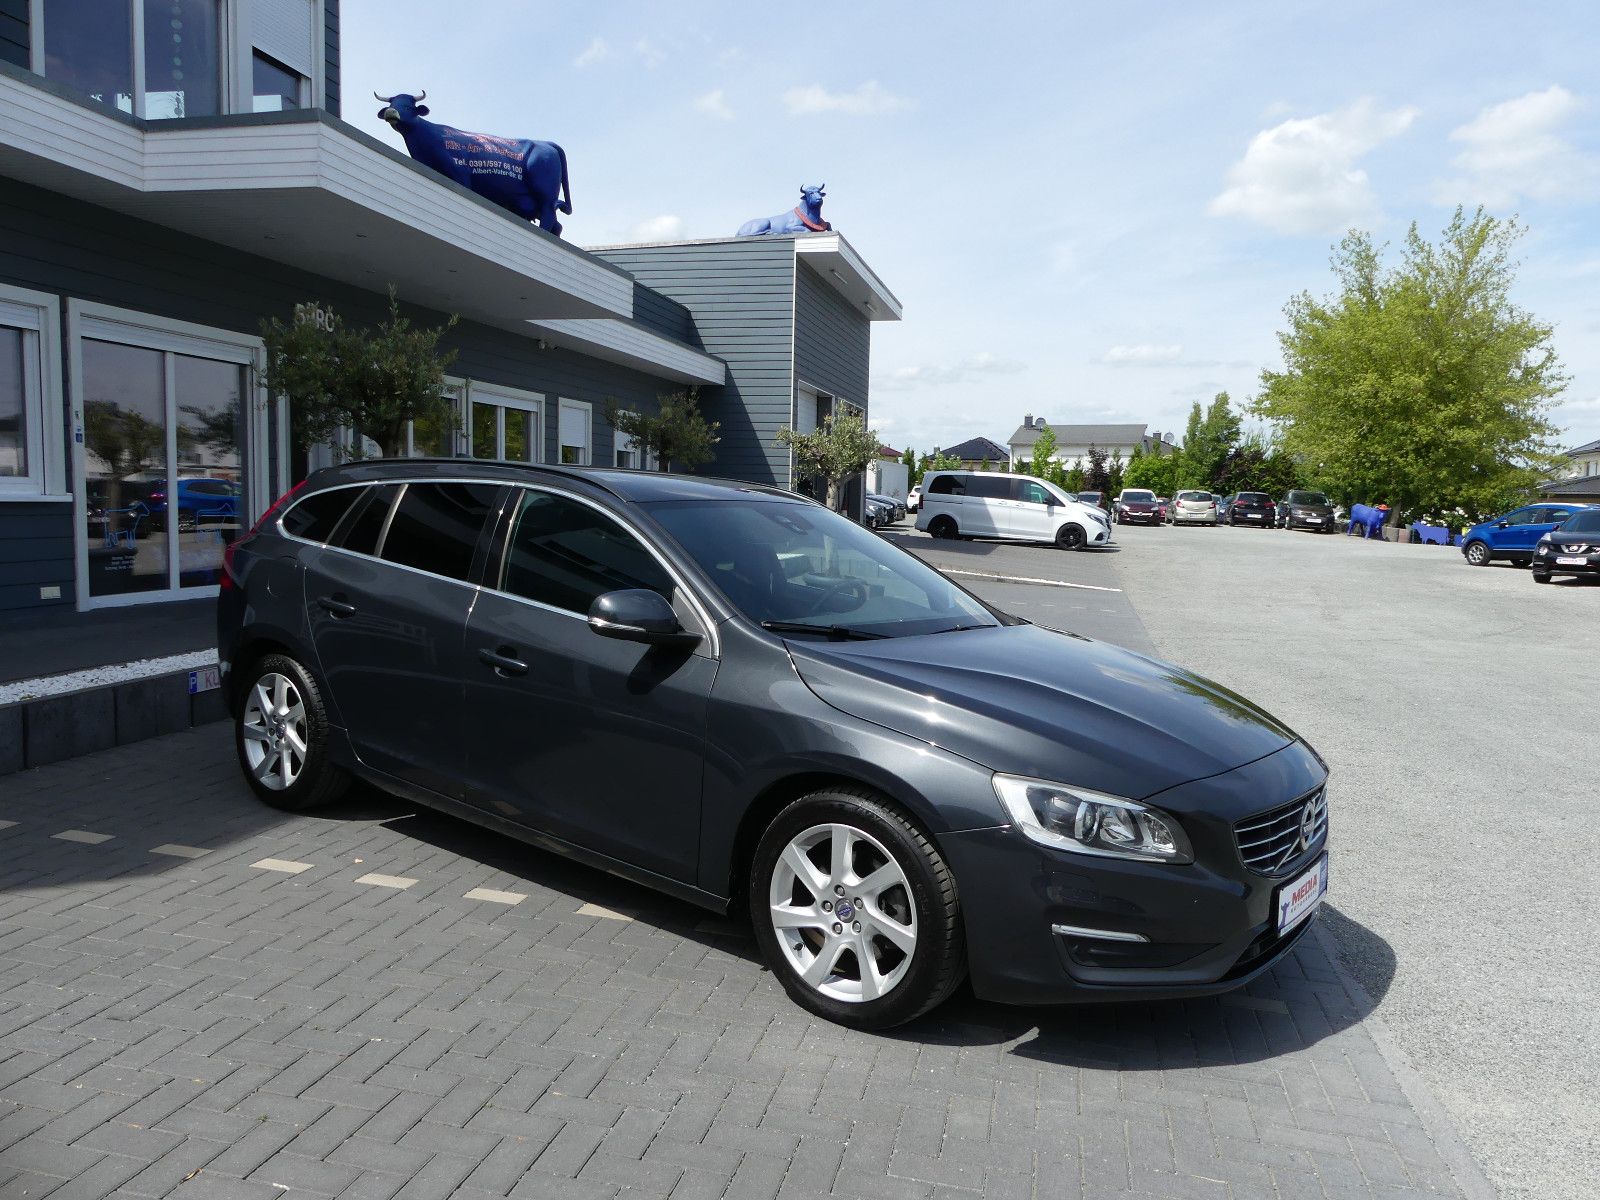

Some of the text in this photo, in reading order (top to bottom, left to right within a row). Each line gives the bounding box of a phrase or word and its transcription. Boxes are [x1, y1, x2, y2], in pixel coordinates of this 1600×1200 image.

[453, 157, 468, 166] Tel.
[511, 165, 523, 174] 100
[190, 676, 197, 690] P
[1291, 873, 1318, 906] MEDIA
